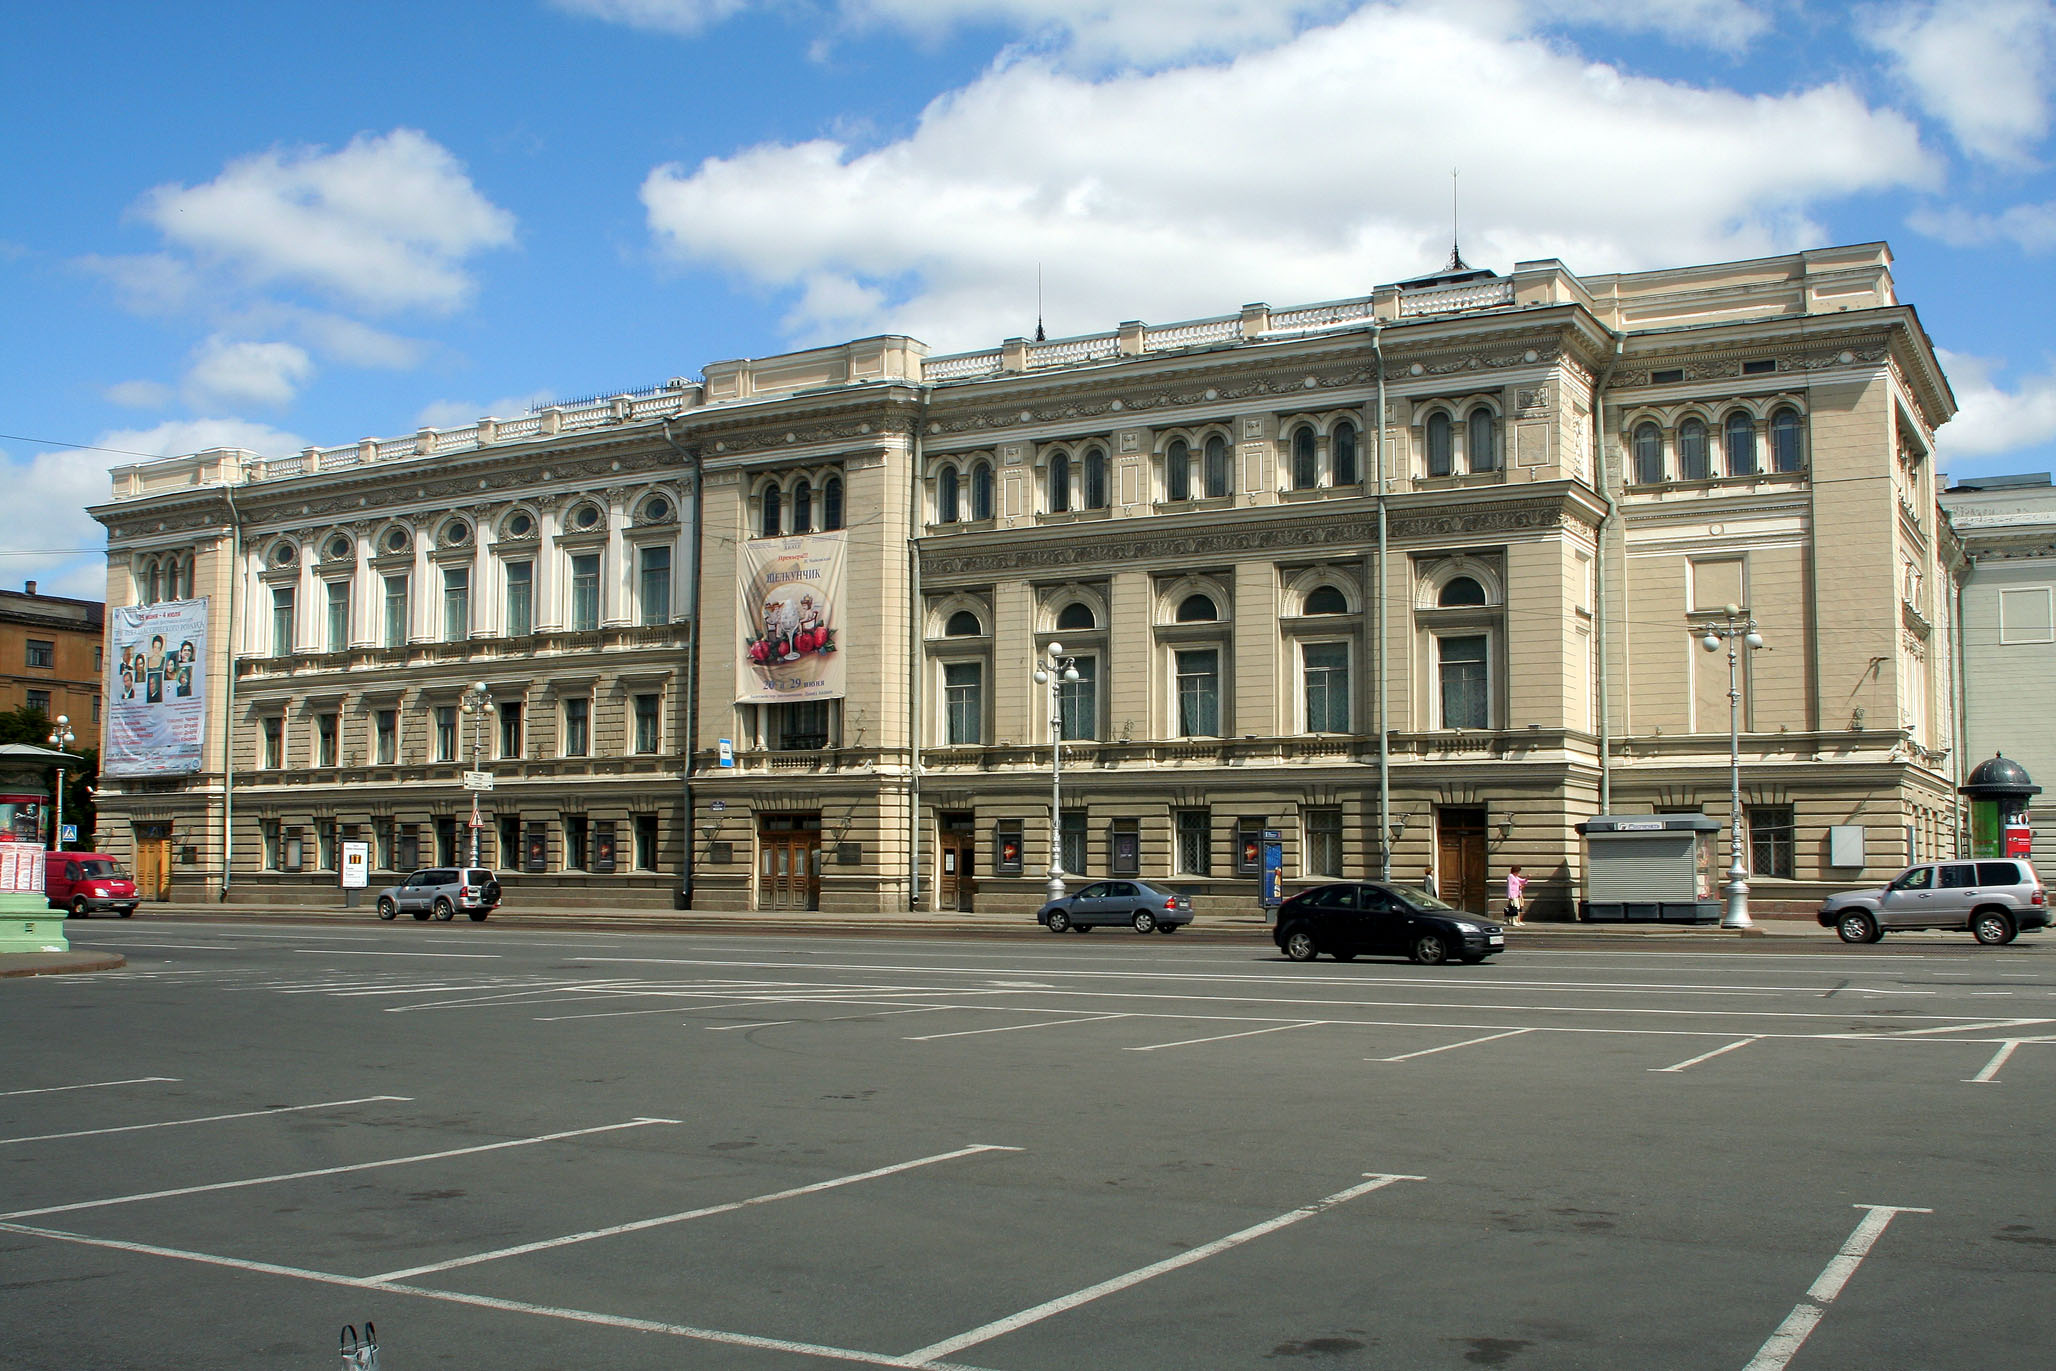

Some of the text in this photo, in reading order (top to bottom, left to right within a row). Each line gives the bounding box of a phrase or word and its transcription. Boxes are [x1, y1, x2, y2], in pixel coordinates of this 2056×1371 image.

[767, 569, 821, 583] ЩЕЛКУНЧИК
[763, 679, 775, 690] 20
[789, 678, 802, 689] 29
[803, 680, 825, 688] июня
